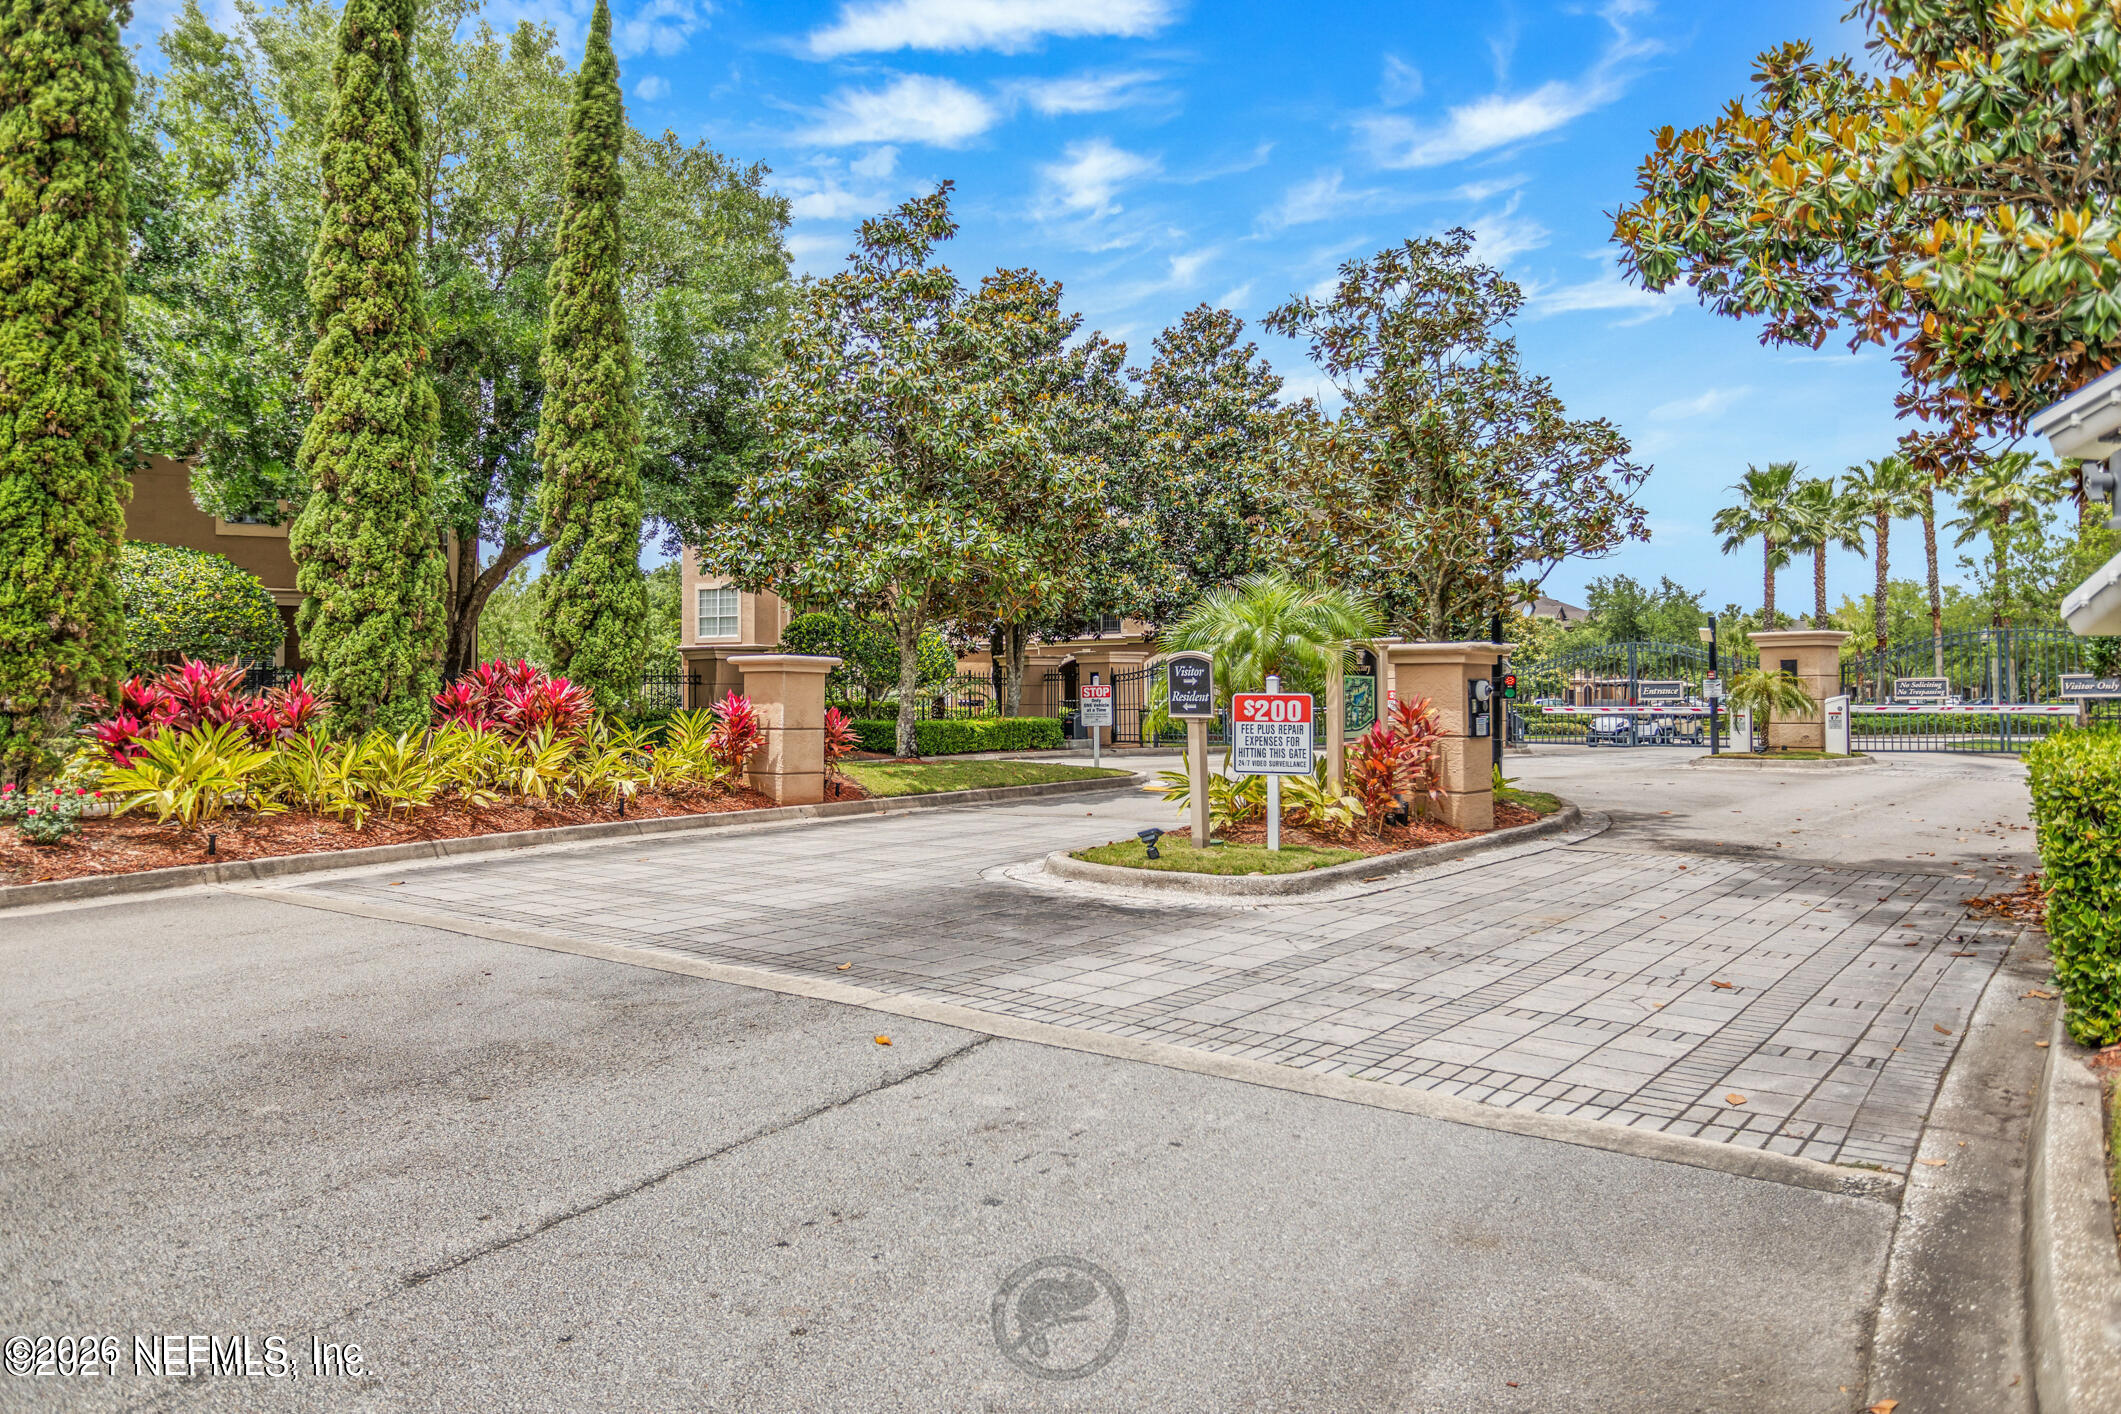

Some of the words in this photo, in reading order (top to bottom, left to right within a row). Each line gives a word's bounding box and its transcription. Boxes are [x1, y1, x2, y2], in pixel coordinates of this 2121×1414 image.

[1174, 665, 1205, 677] Visitor
[1911, 681, 1943, 689] Soliciting
[2064, 682, 2095, 690] Visitor
[2097, 681, 2120, 692] Only
[1083, 687, 1110, 697] STOP
[1171, 690, 1210, 702] Resident
[1643, 687, 1679, 695] Entrance
[1909, 688, 1946, 697] Trespassing
[1243, 699, 1302, 722] $200
[1240, 724, 1255, 735] FEE
[1257, 724, 1276, 735] PLUS
[1278, 724, 1304, 735] REPAIR
[1244, 735, 1284, 747] EXPENSES
[1285, 736, 1300, 747] FOR
[1238, 747, 1267, 758] HITTING
[1269, 748, 1286, 759] THIS
[1288, 748, 1307, 759] GATE
[1238, 759, 1250, 767] 24/7
[1268, 760, 1307, 768] SURVEILLANCE
